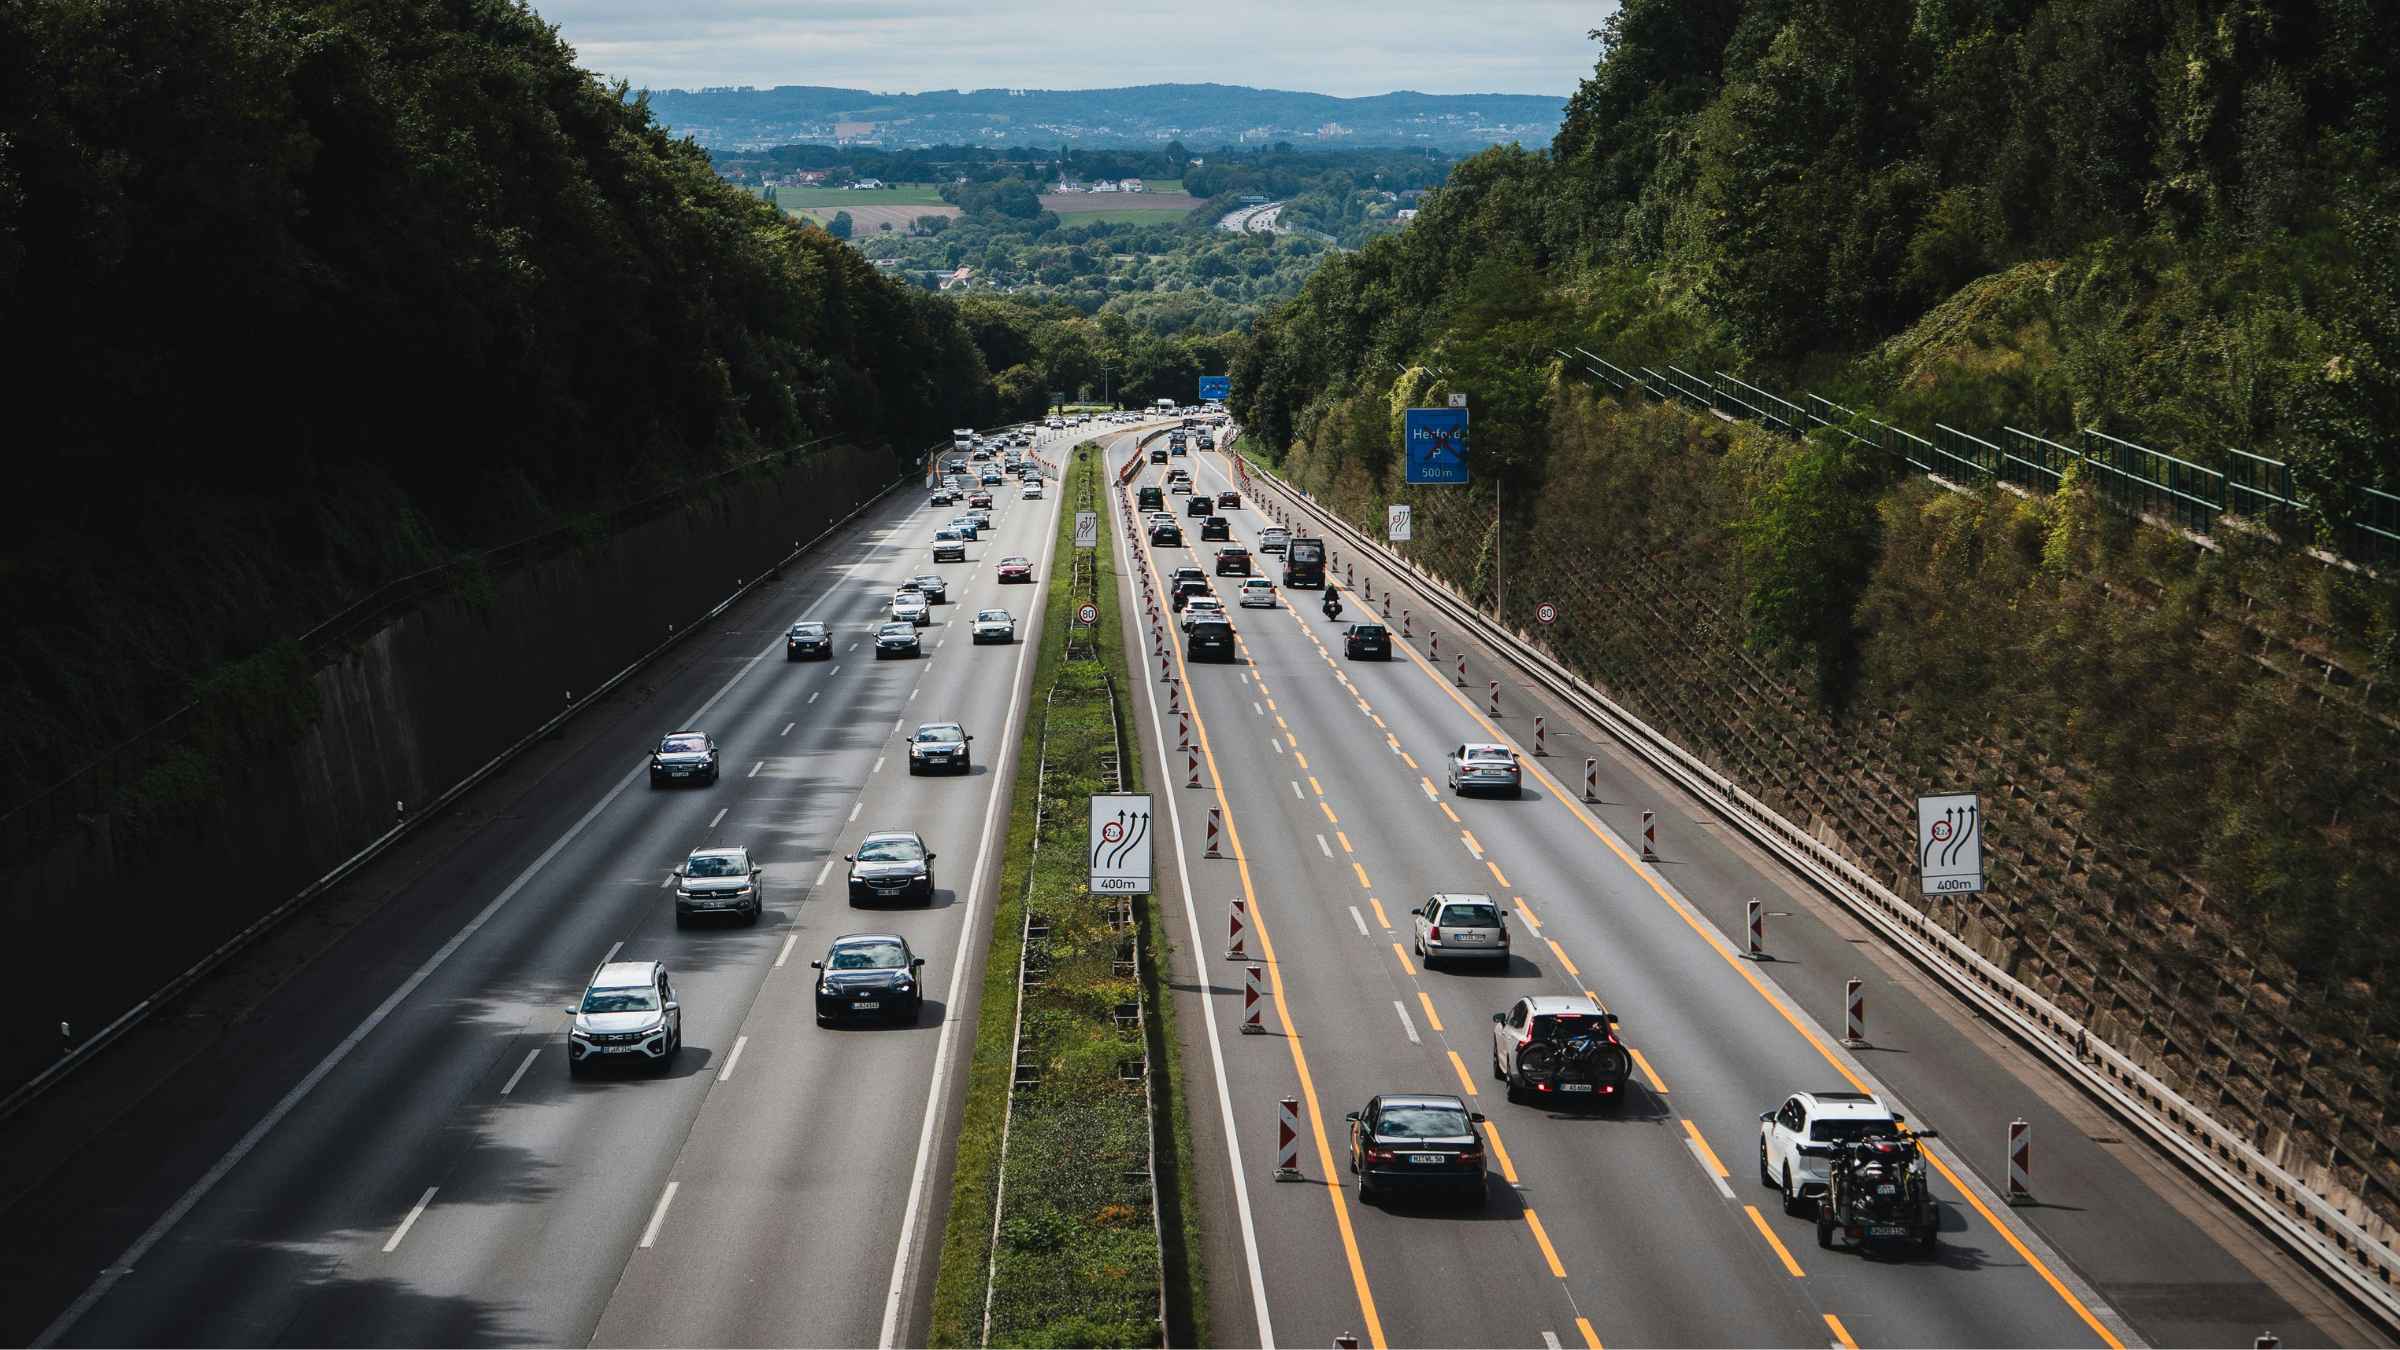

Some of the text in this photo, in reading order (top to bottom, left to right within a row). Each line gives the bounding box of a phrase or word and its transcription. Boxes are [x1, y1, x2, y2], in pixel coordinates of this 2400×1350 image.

[1082, 609, 1095, 619] 80
[1540, 608, 1553, 618] 80
[1101, 879, 1136, 889] 400m
[1936, 880, 1972, 890] 400m
